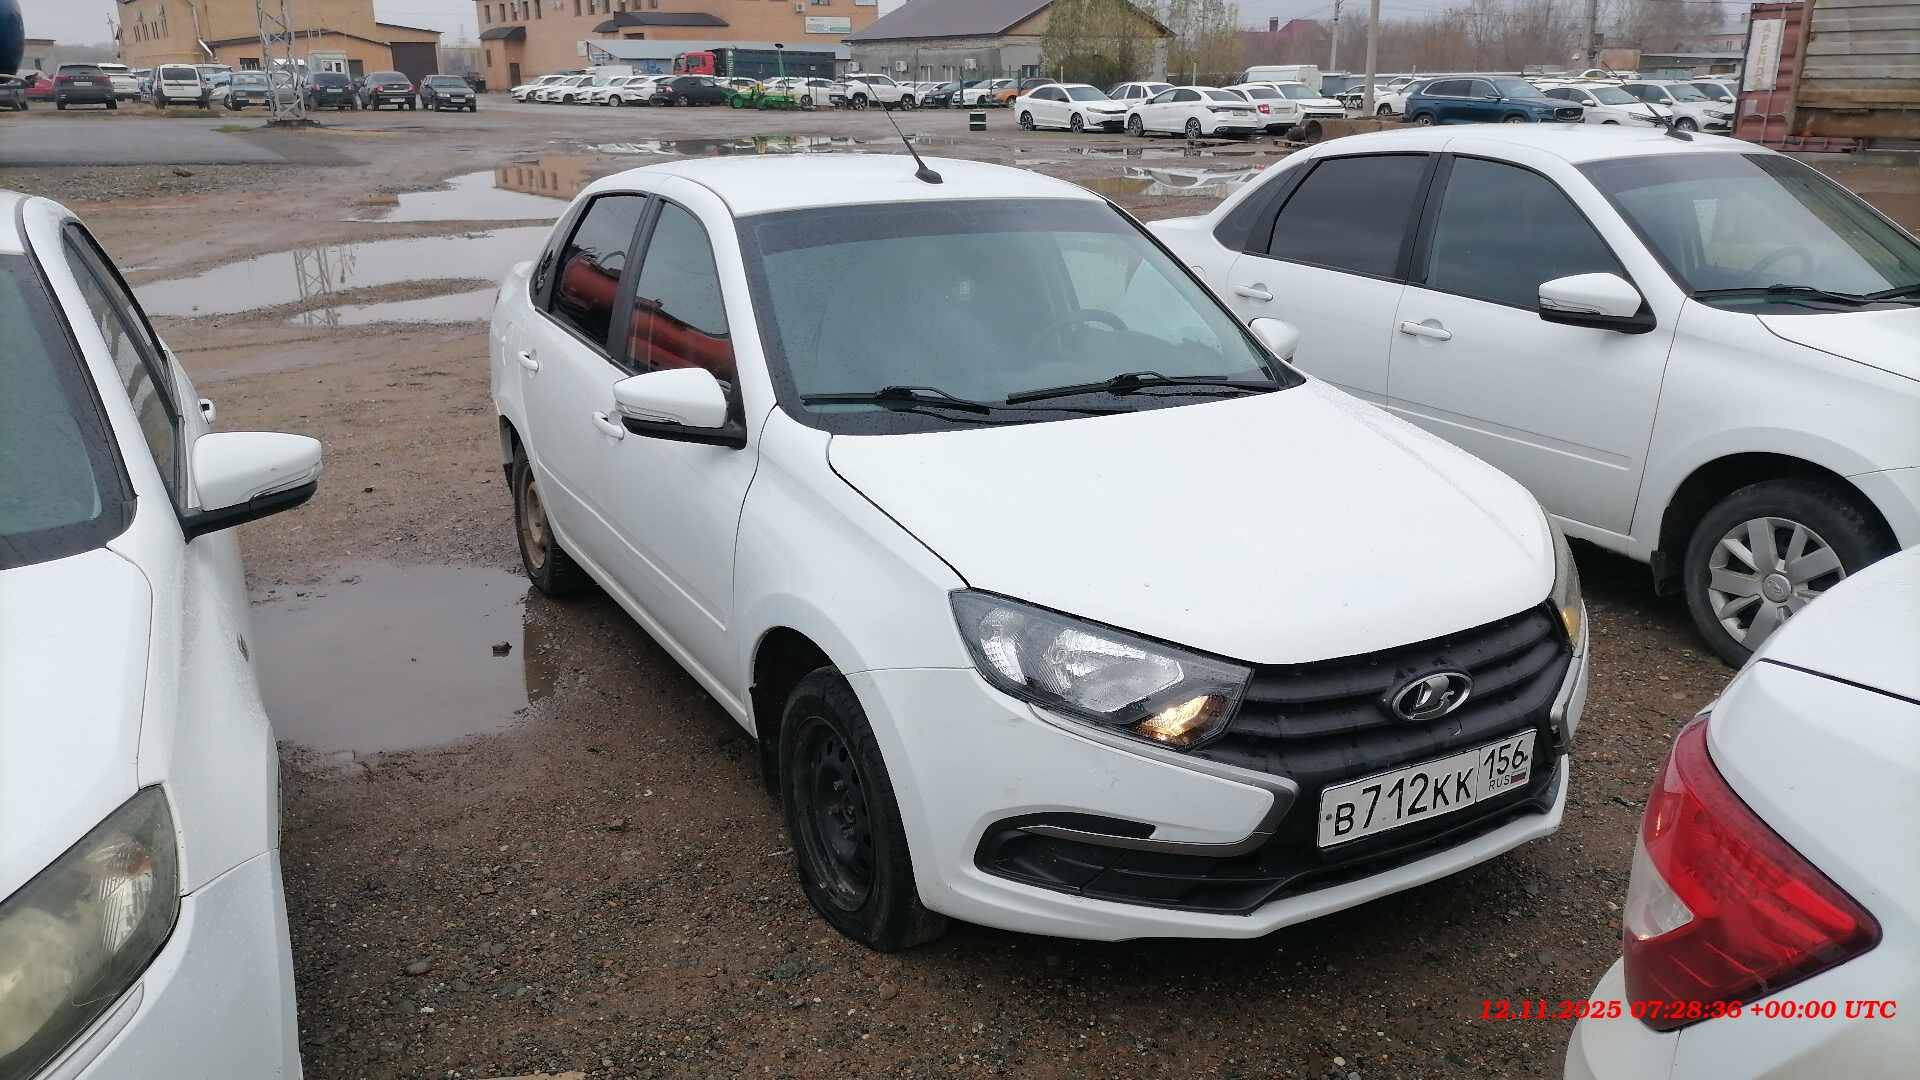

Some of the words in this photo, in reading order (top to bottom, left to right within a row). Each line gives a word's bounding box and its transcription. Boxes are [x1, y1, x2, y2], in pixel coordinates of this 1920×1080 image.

[1334, 767, 1474, 837] В712КК
[1483, 739, 1525, 780] 156
[1488, 775, 1511, 792] RUS
